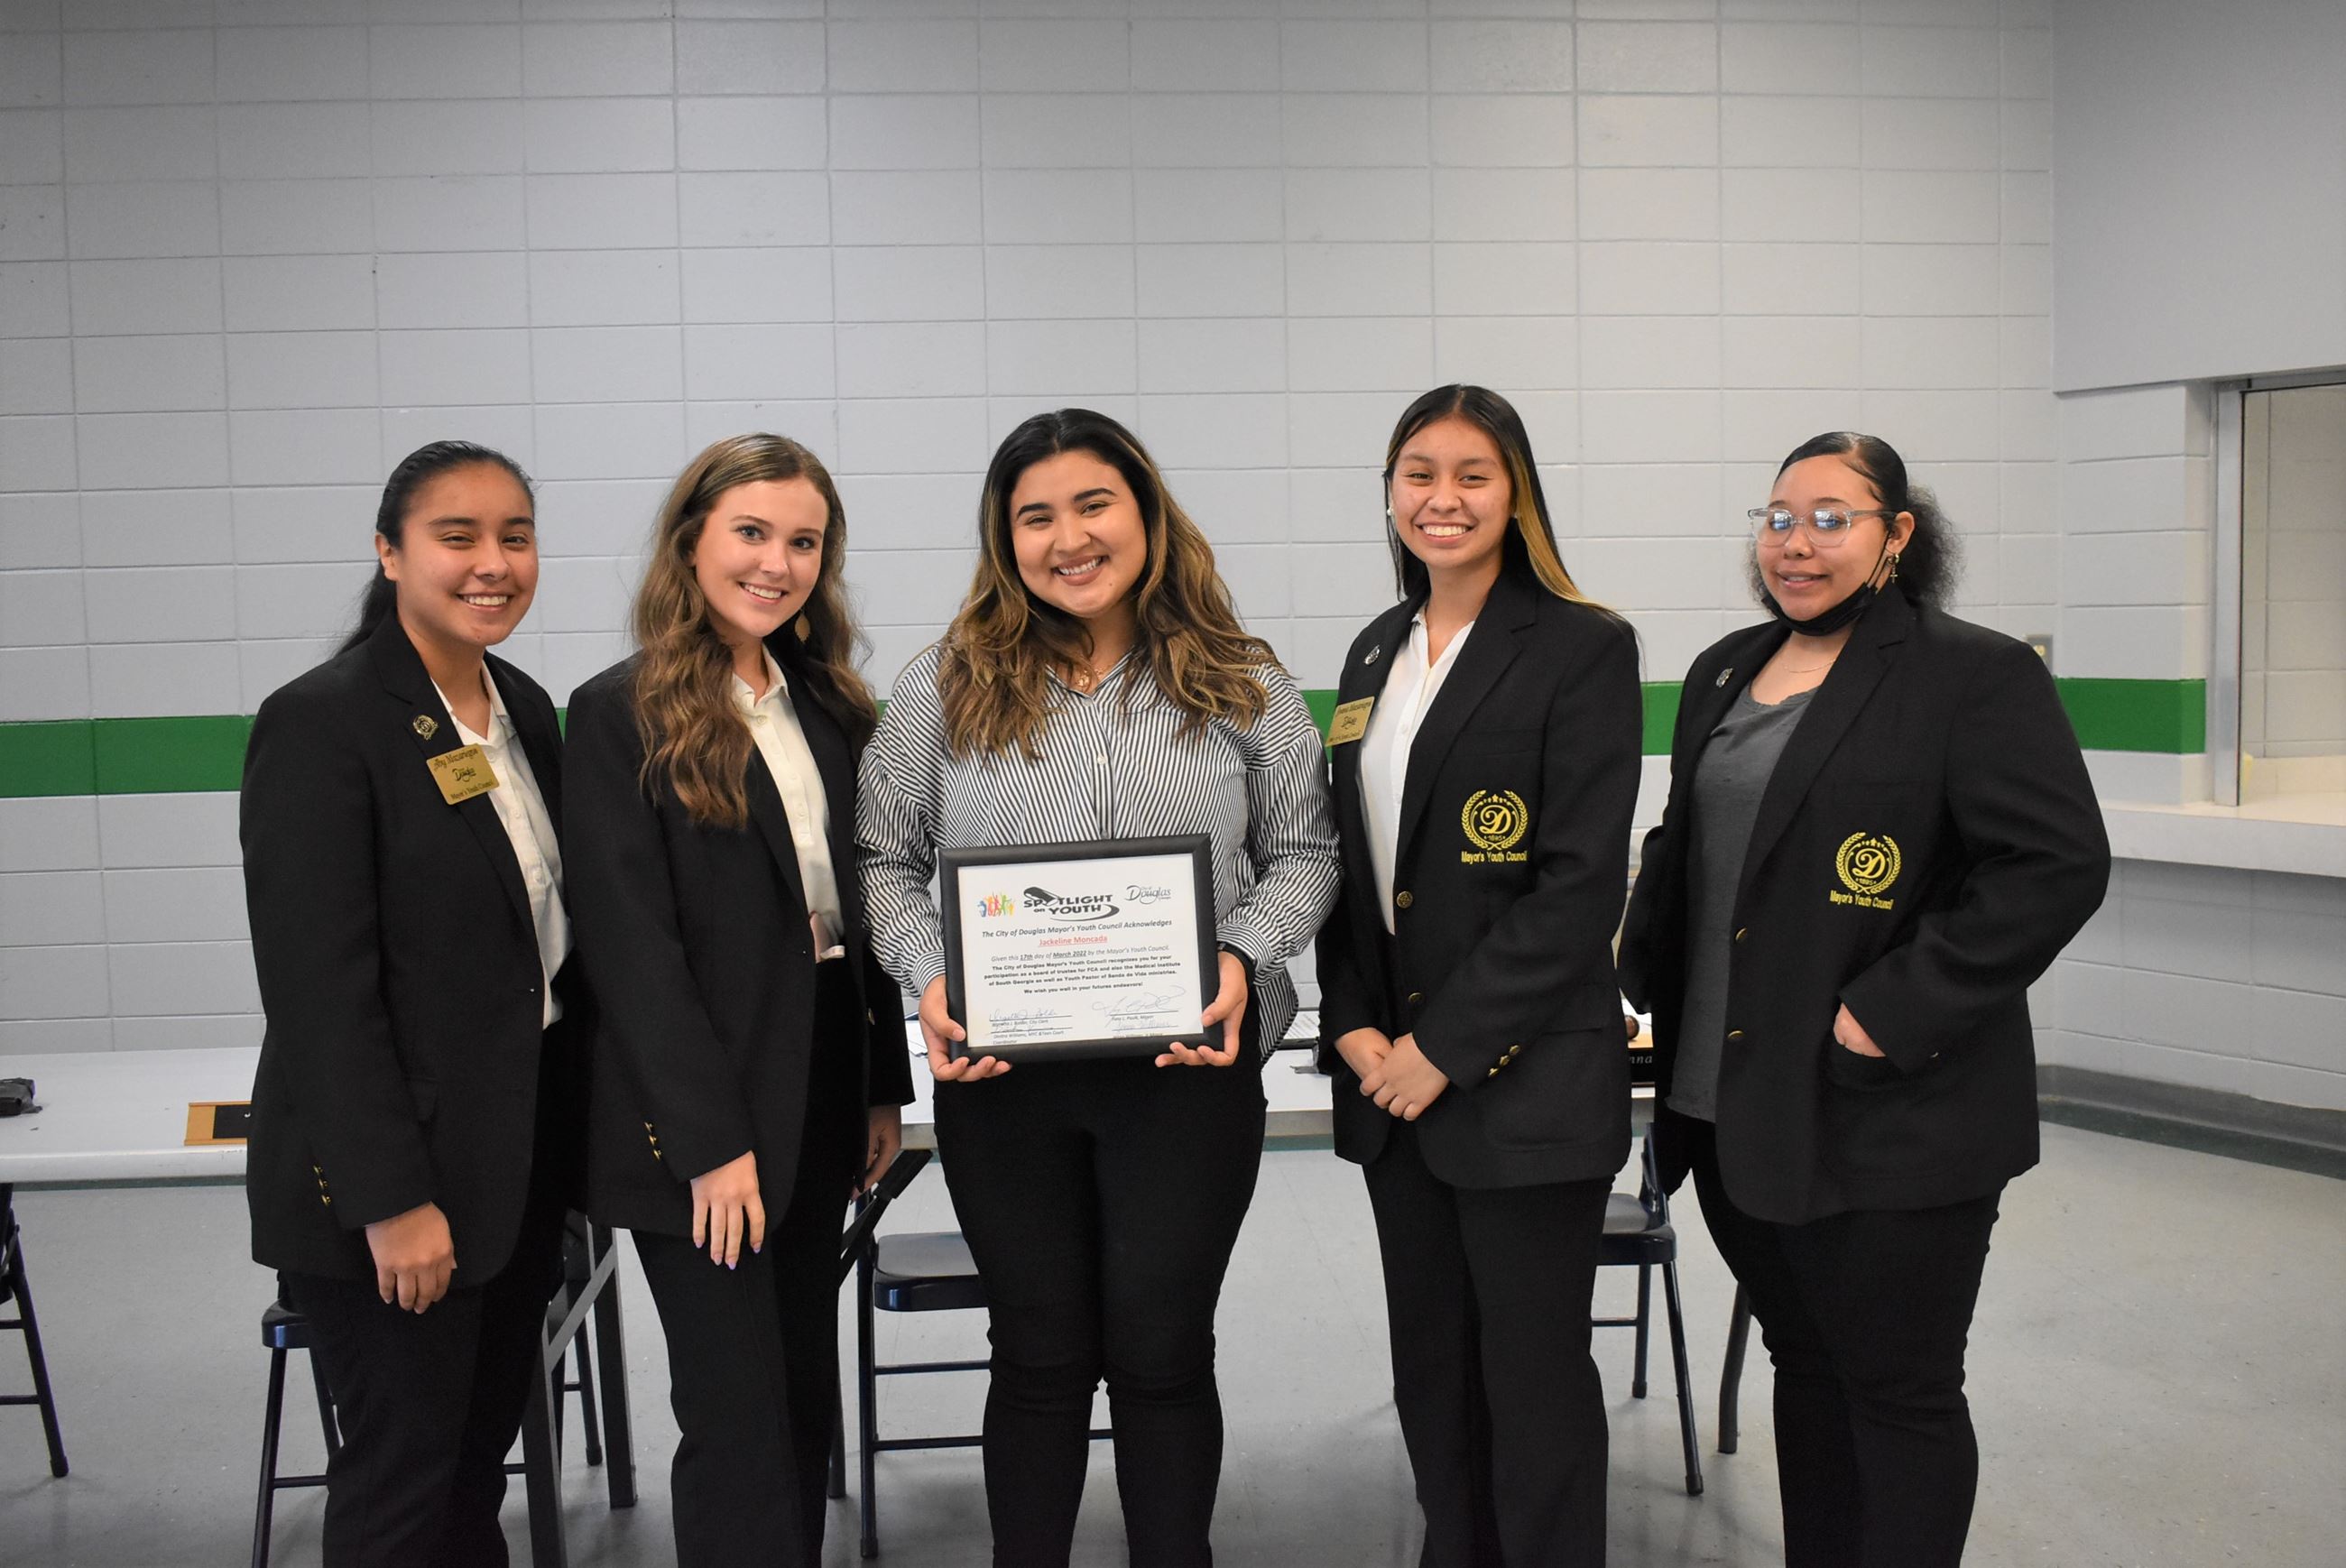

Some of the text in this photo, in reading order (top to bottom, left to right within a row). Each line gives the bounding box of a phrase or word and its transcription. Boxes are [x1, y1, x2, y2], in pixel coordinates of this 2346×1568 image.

[1461, 850, 1528, 864] Mayor's Youth Council
[1124, 885, 1171, 905] Douglas
[1829, 890, 1894, 910] Mayor's Youth Council
[1048, 904, 1102, 915] YOUTH
[1019, 927, 1046, 936] Douglas
[1047, 925, 1075, 934] Mayor's
[1097, 922, 1122, 930] Council
[1123, 918, 1172, 927] Acknowledges
[1039, 936, 1108, 945] Jackeline Moncada
